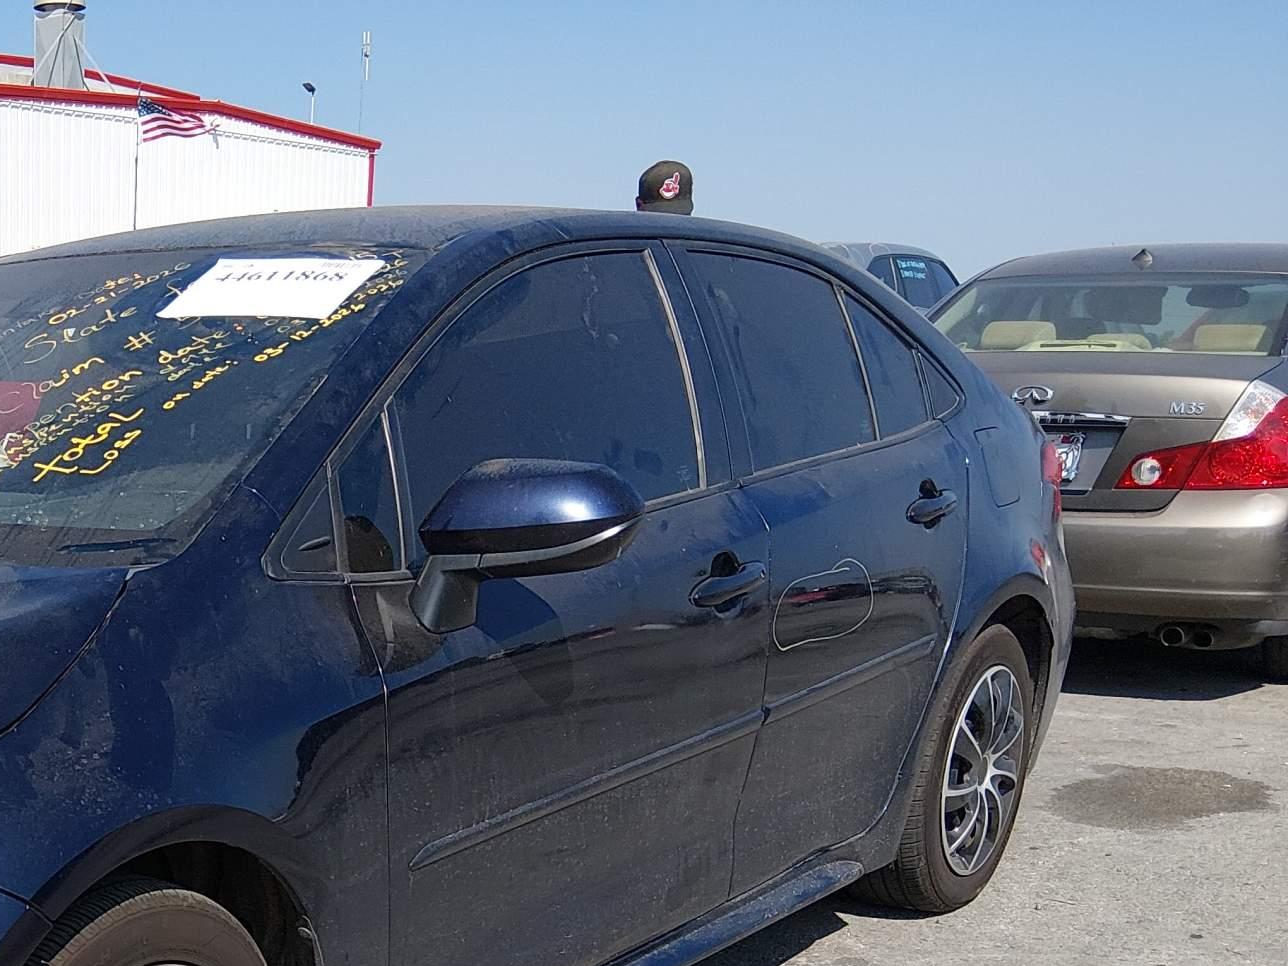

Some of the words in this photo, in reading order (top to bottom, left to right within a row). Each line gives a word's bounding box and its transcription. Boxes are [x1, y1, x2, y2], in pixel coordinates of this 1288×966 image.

[215, 270, 349, 283] 44611868
[23, 306, 138, 365] State
[123, 330, 156, 352] #
[1168, 400, 1206, 416] M35
